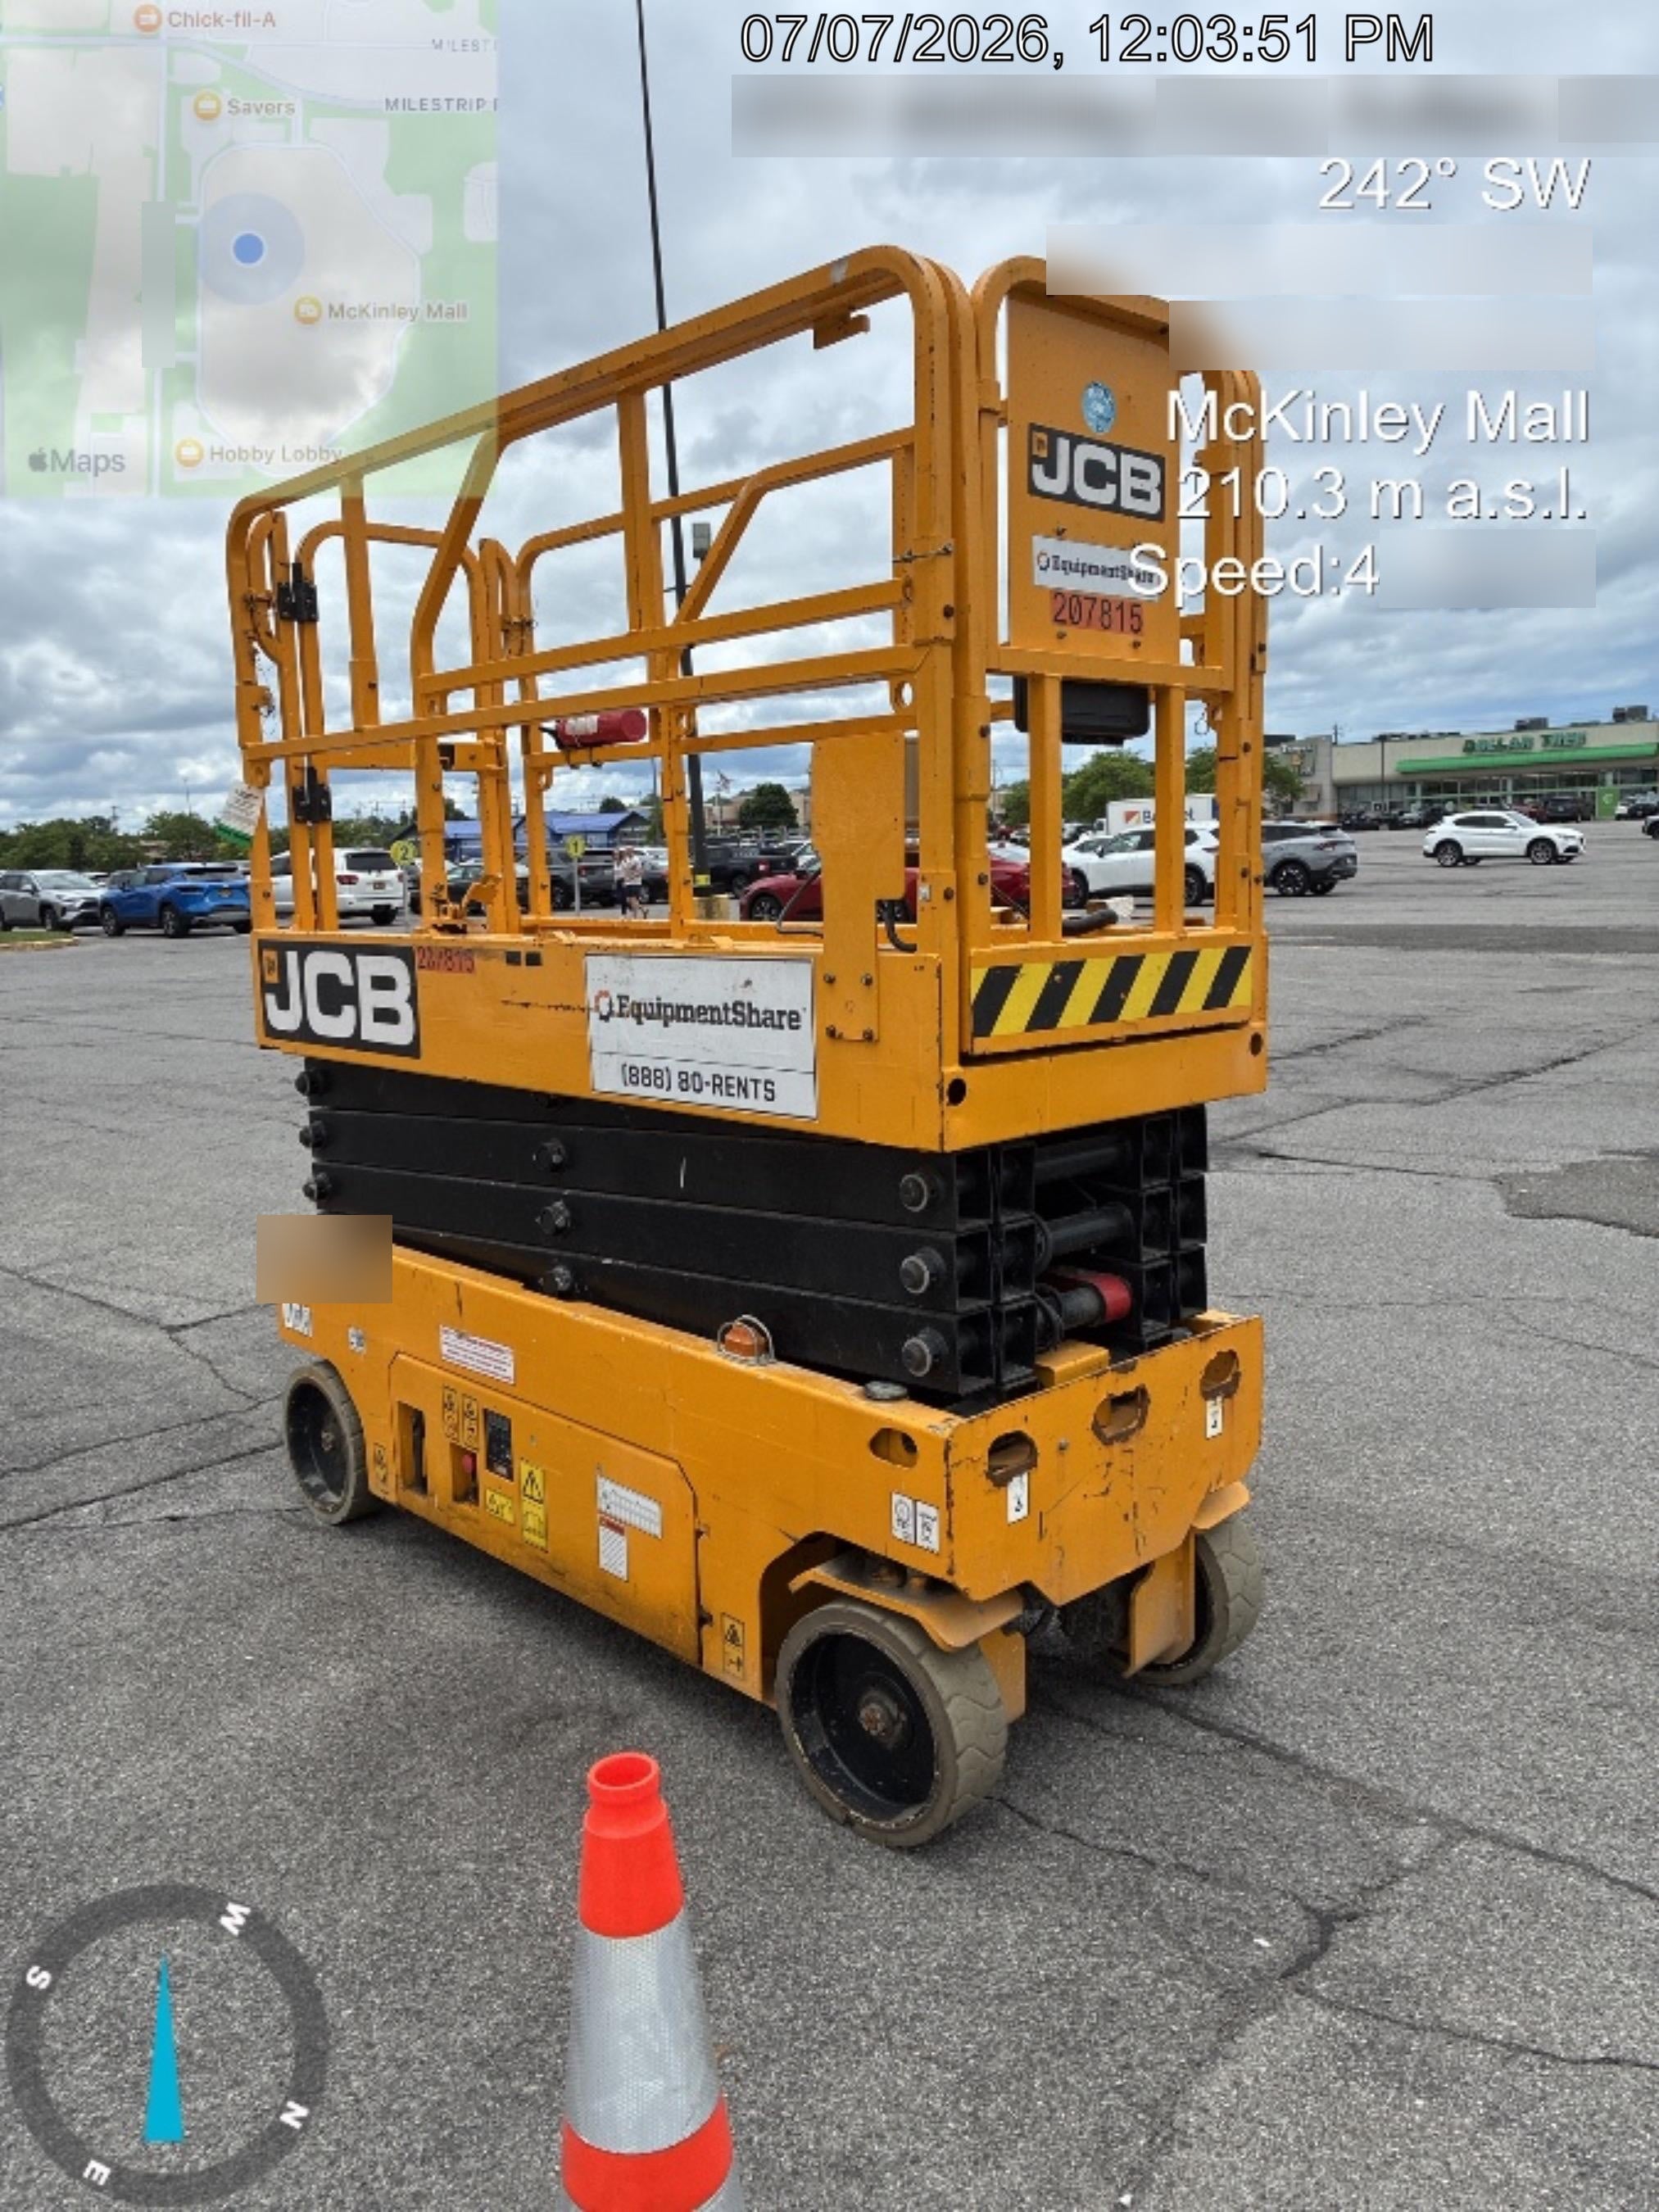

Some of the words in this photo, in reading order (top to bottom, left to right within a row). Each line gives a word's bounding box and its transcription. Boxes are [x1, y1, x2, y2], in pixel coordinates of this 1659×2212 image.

[1032, 436, 1161, 514] JCB
[1053, 592, 1144, 634] 207815
[265, 950, 415, 1045] JCB
[616, 994, 802, 1030] EquipmentShare
[621, 1063, 672, 1092] (888)
[678, 1070, 776, 1102] 80-RENTS
